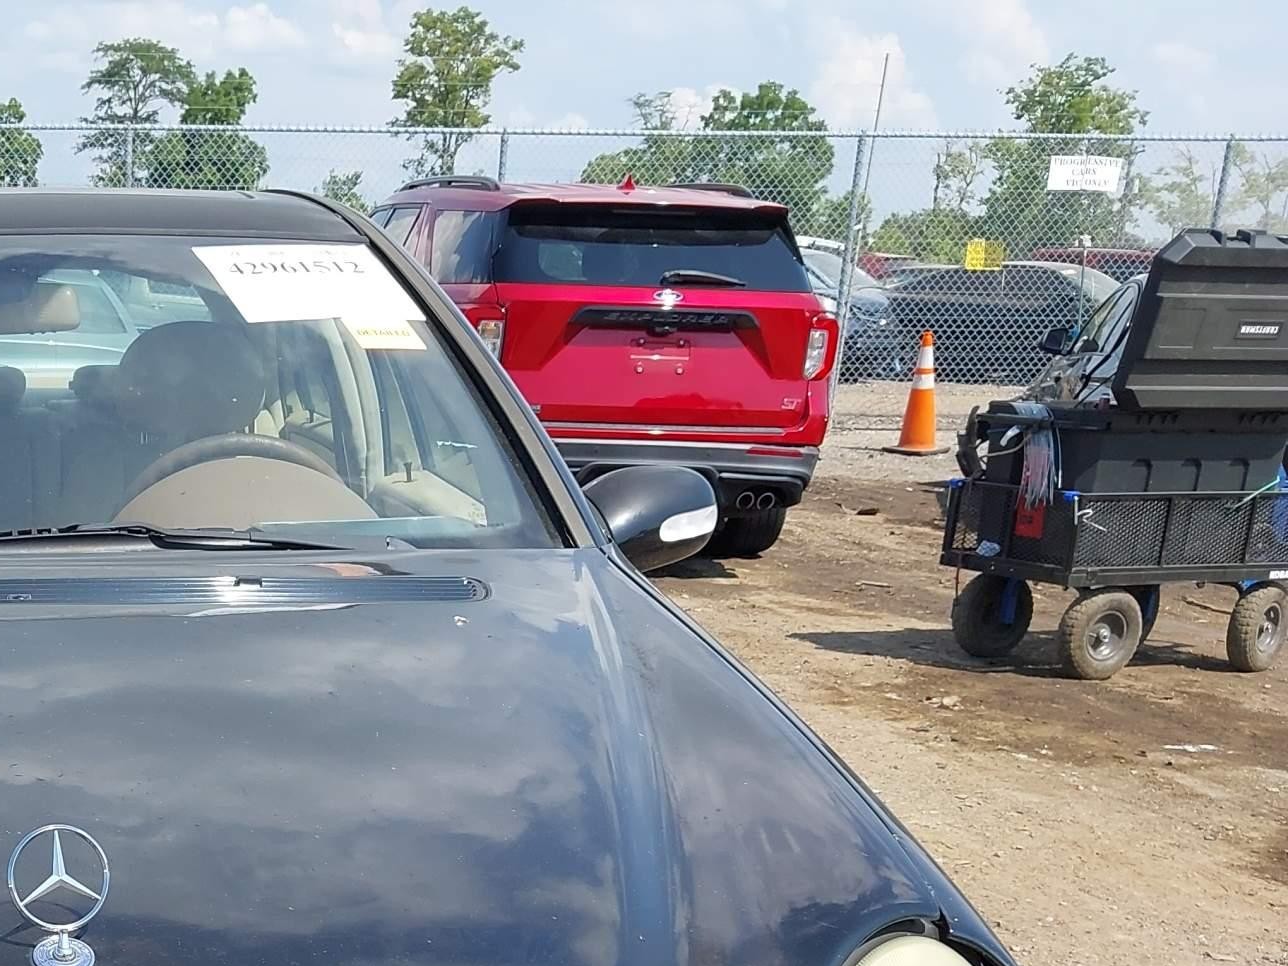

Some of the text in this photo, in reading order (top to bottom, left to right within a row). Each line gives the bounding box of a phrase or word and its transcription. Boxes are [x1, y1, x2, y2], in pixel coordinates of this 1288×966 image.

[1072, 167, 1096, 176] CARS
[230, 261, 365, 275] 42961512
[603, 312, 729, 325] EXPLORER
[781, 398, 802, 410] ST
